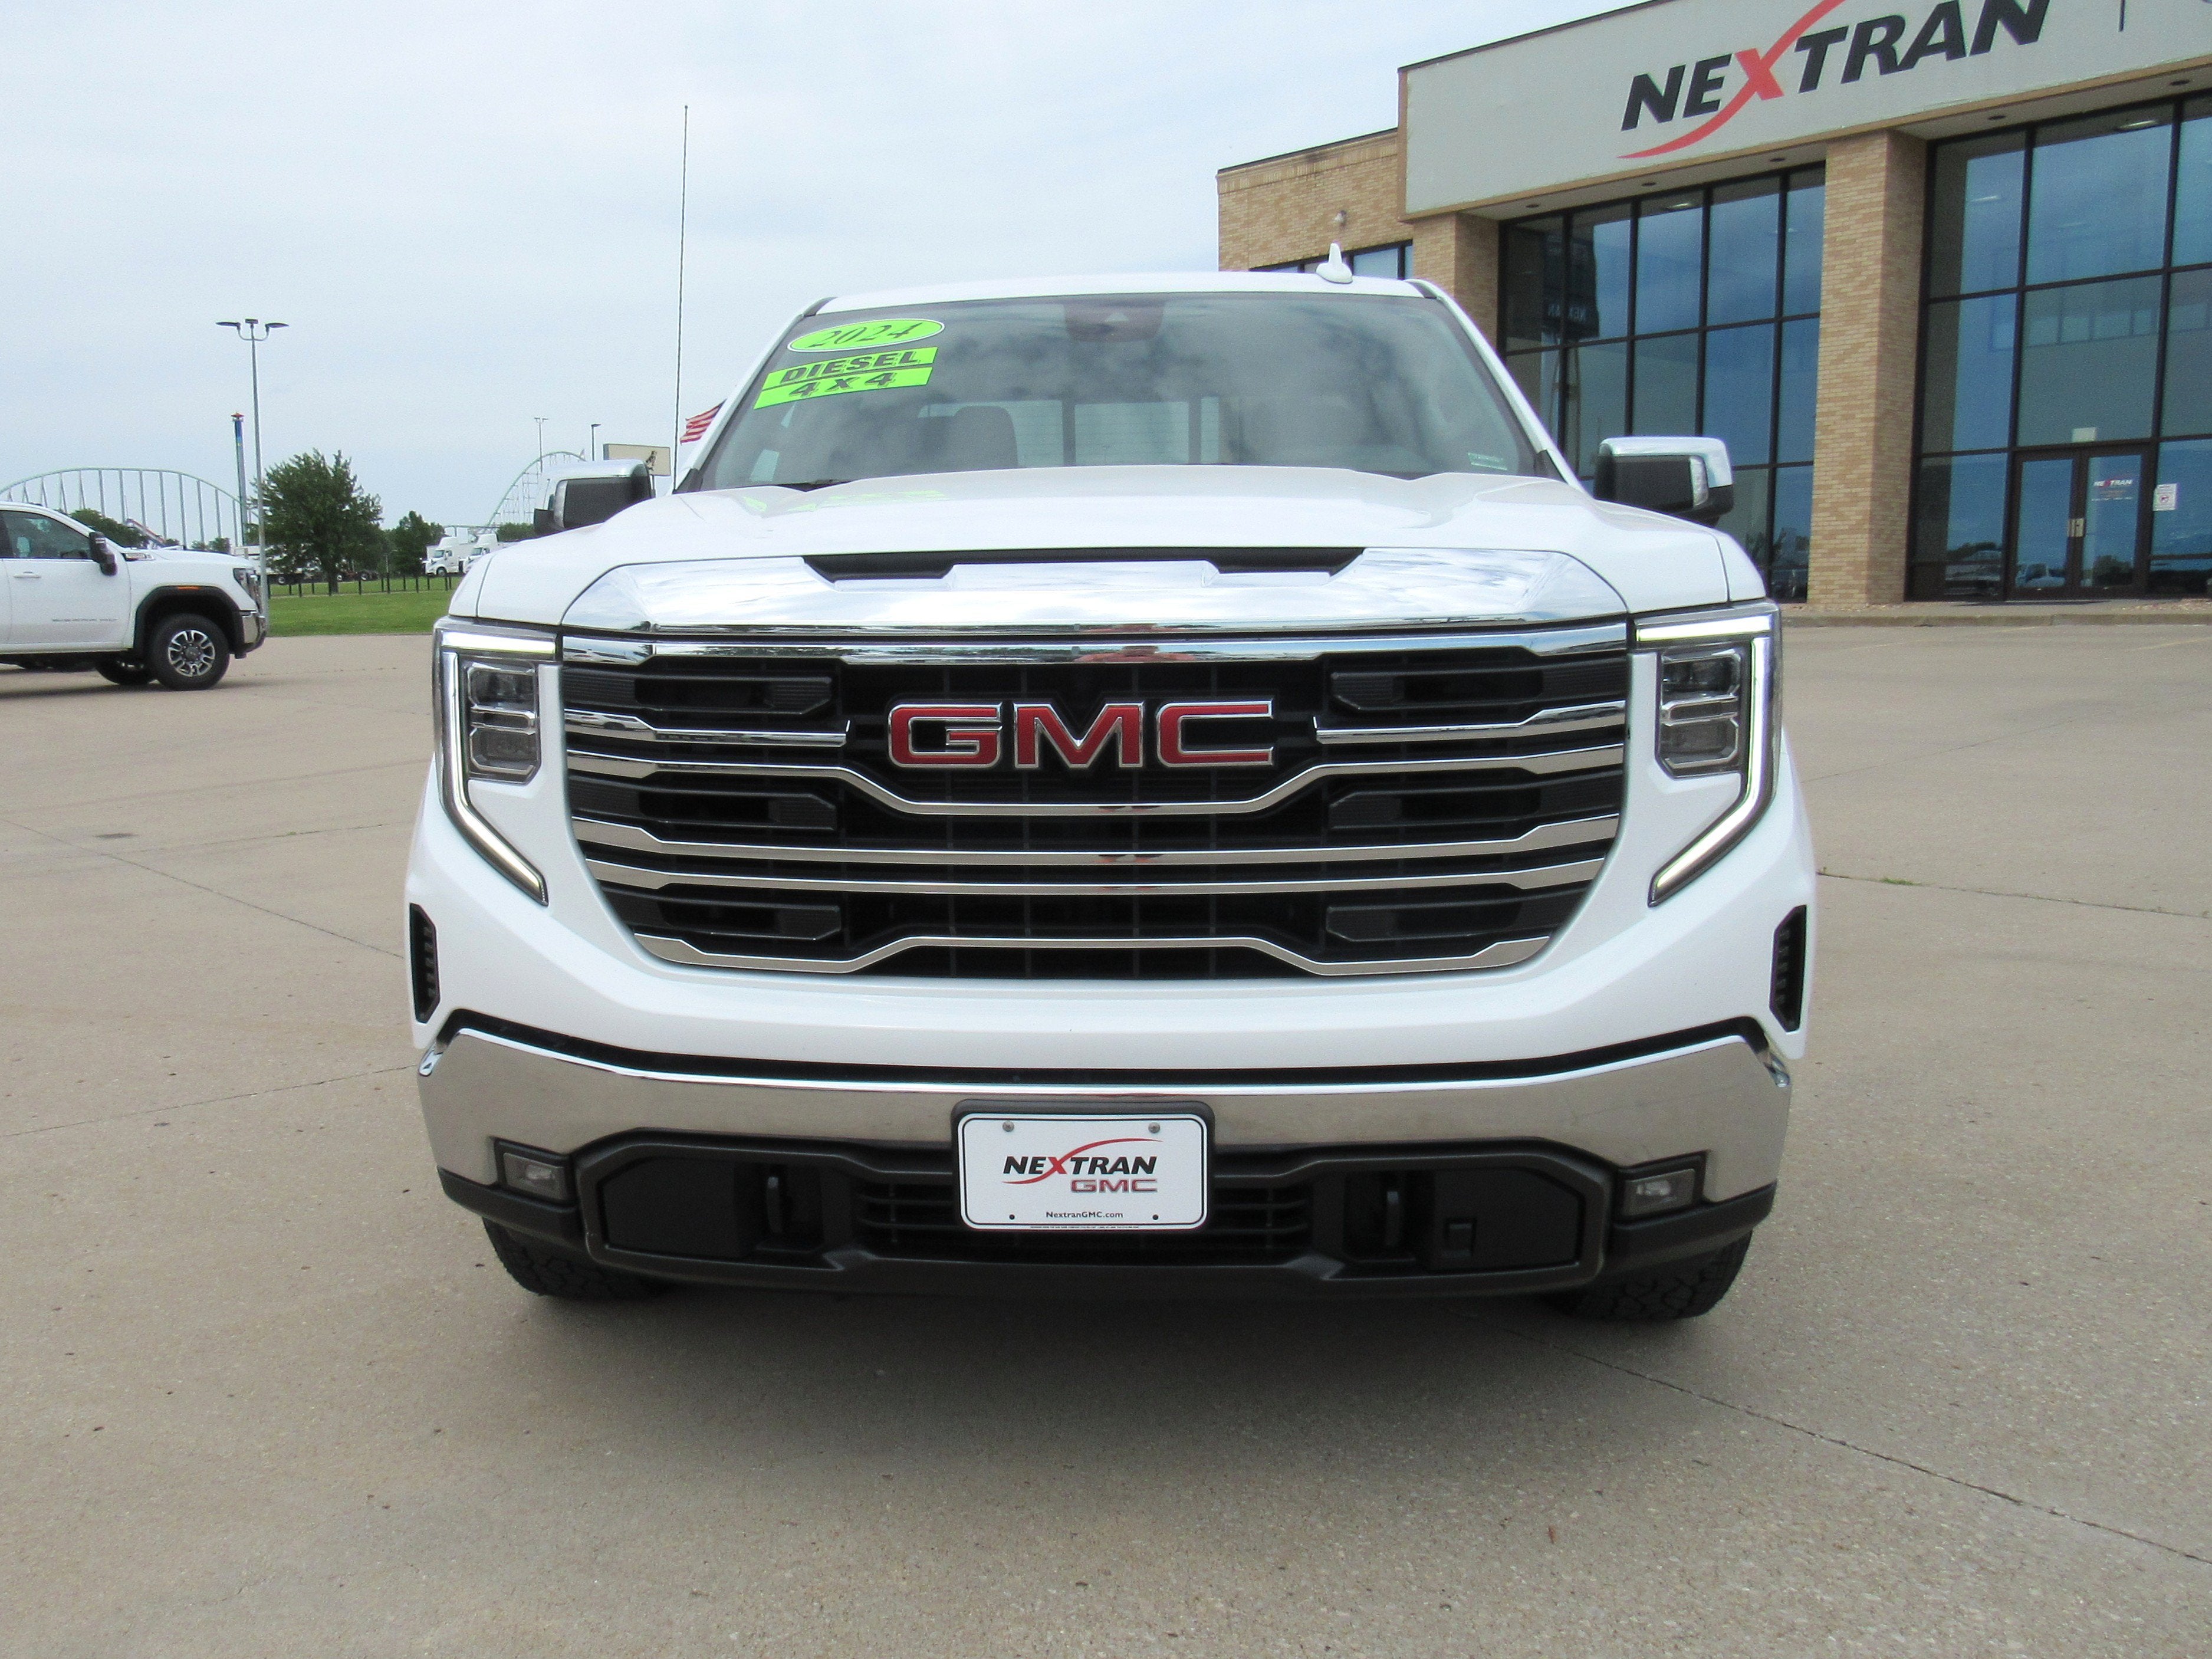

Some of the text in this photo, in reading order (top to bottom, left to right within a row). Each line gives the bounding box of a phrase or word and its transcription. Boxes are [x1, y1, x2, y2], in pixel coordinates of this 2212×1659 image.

[1621, 0, 2050, 132] NEXTRAN
[807, 322, 923, 349] 2024
[780, 351, 921, 384] DIESEL
[888, 700, 1274, 767] GMC
[1003, 1156, 1158, 1175] NEXTRAN
[1070, 1179, 1158, 1192] GMC
[1046, 1211, 1123, 1219] NextranGMC.com
